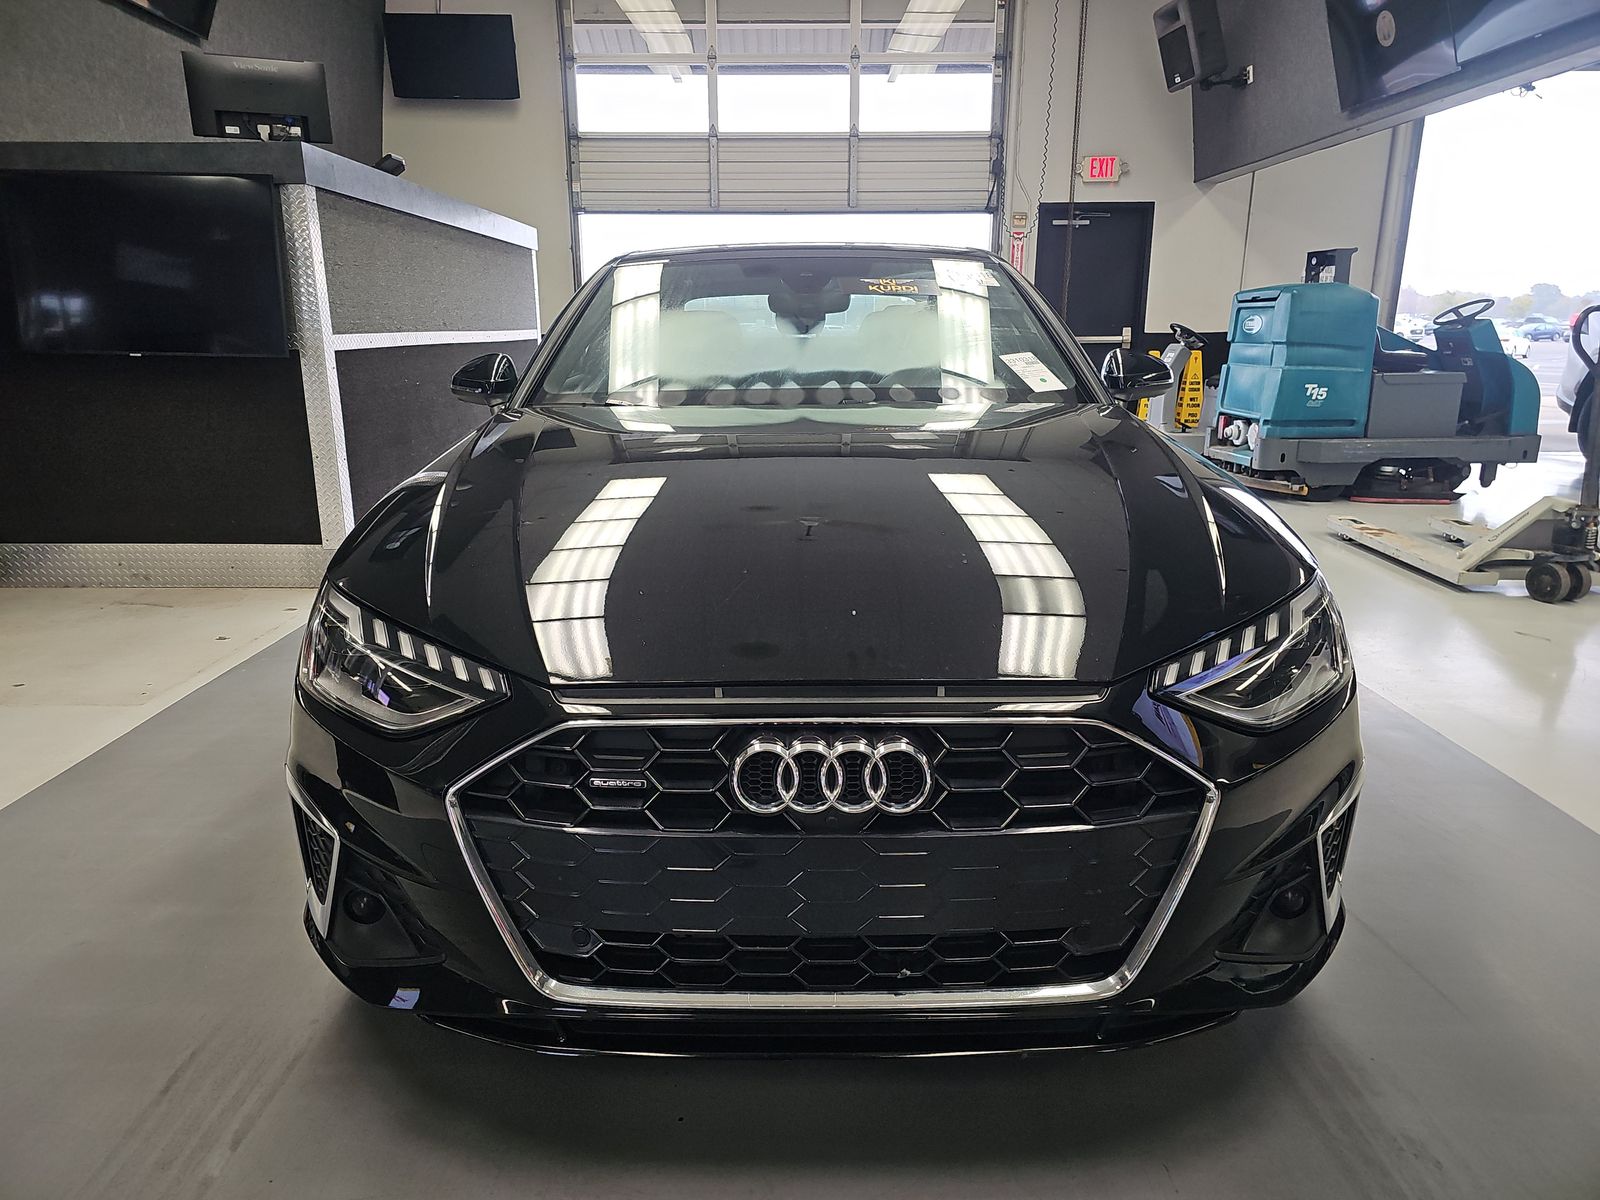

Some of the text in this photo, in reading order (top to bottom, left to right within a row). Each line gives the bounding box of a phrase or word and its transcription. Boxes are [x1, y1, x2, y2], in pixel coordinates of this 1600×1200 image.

[232, 61, 279, 73] ViewSonic
[1089, 157, 1116, 178] EXIT
[868, 284, 919, 294] KURDI
[1304, 384, 1329, 400] T15
[593, 780, 642, 788] quattro
